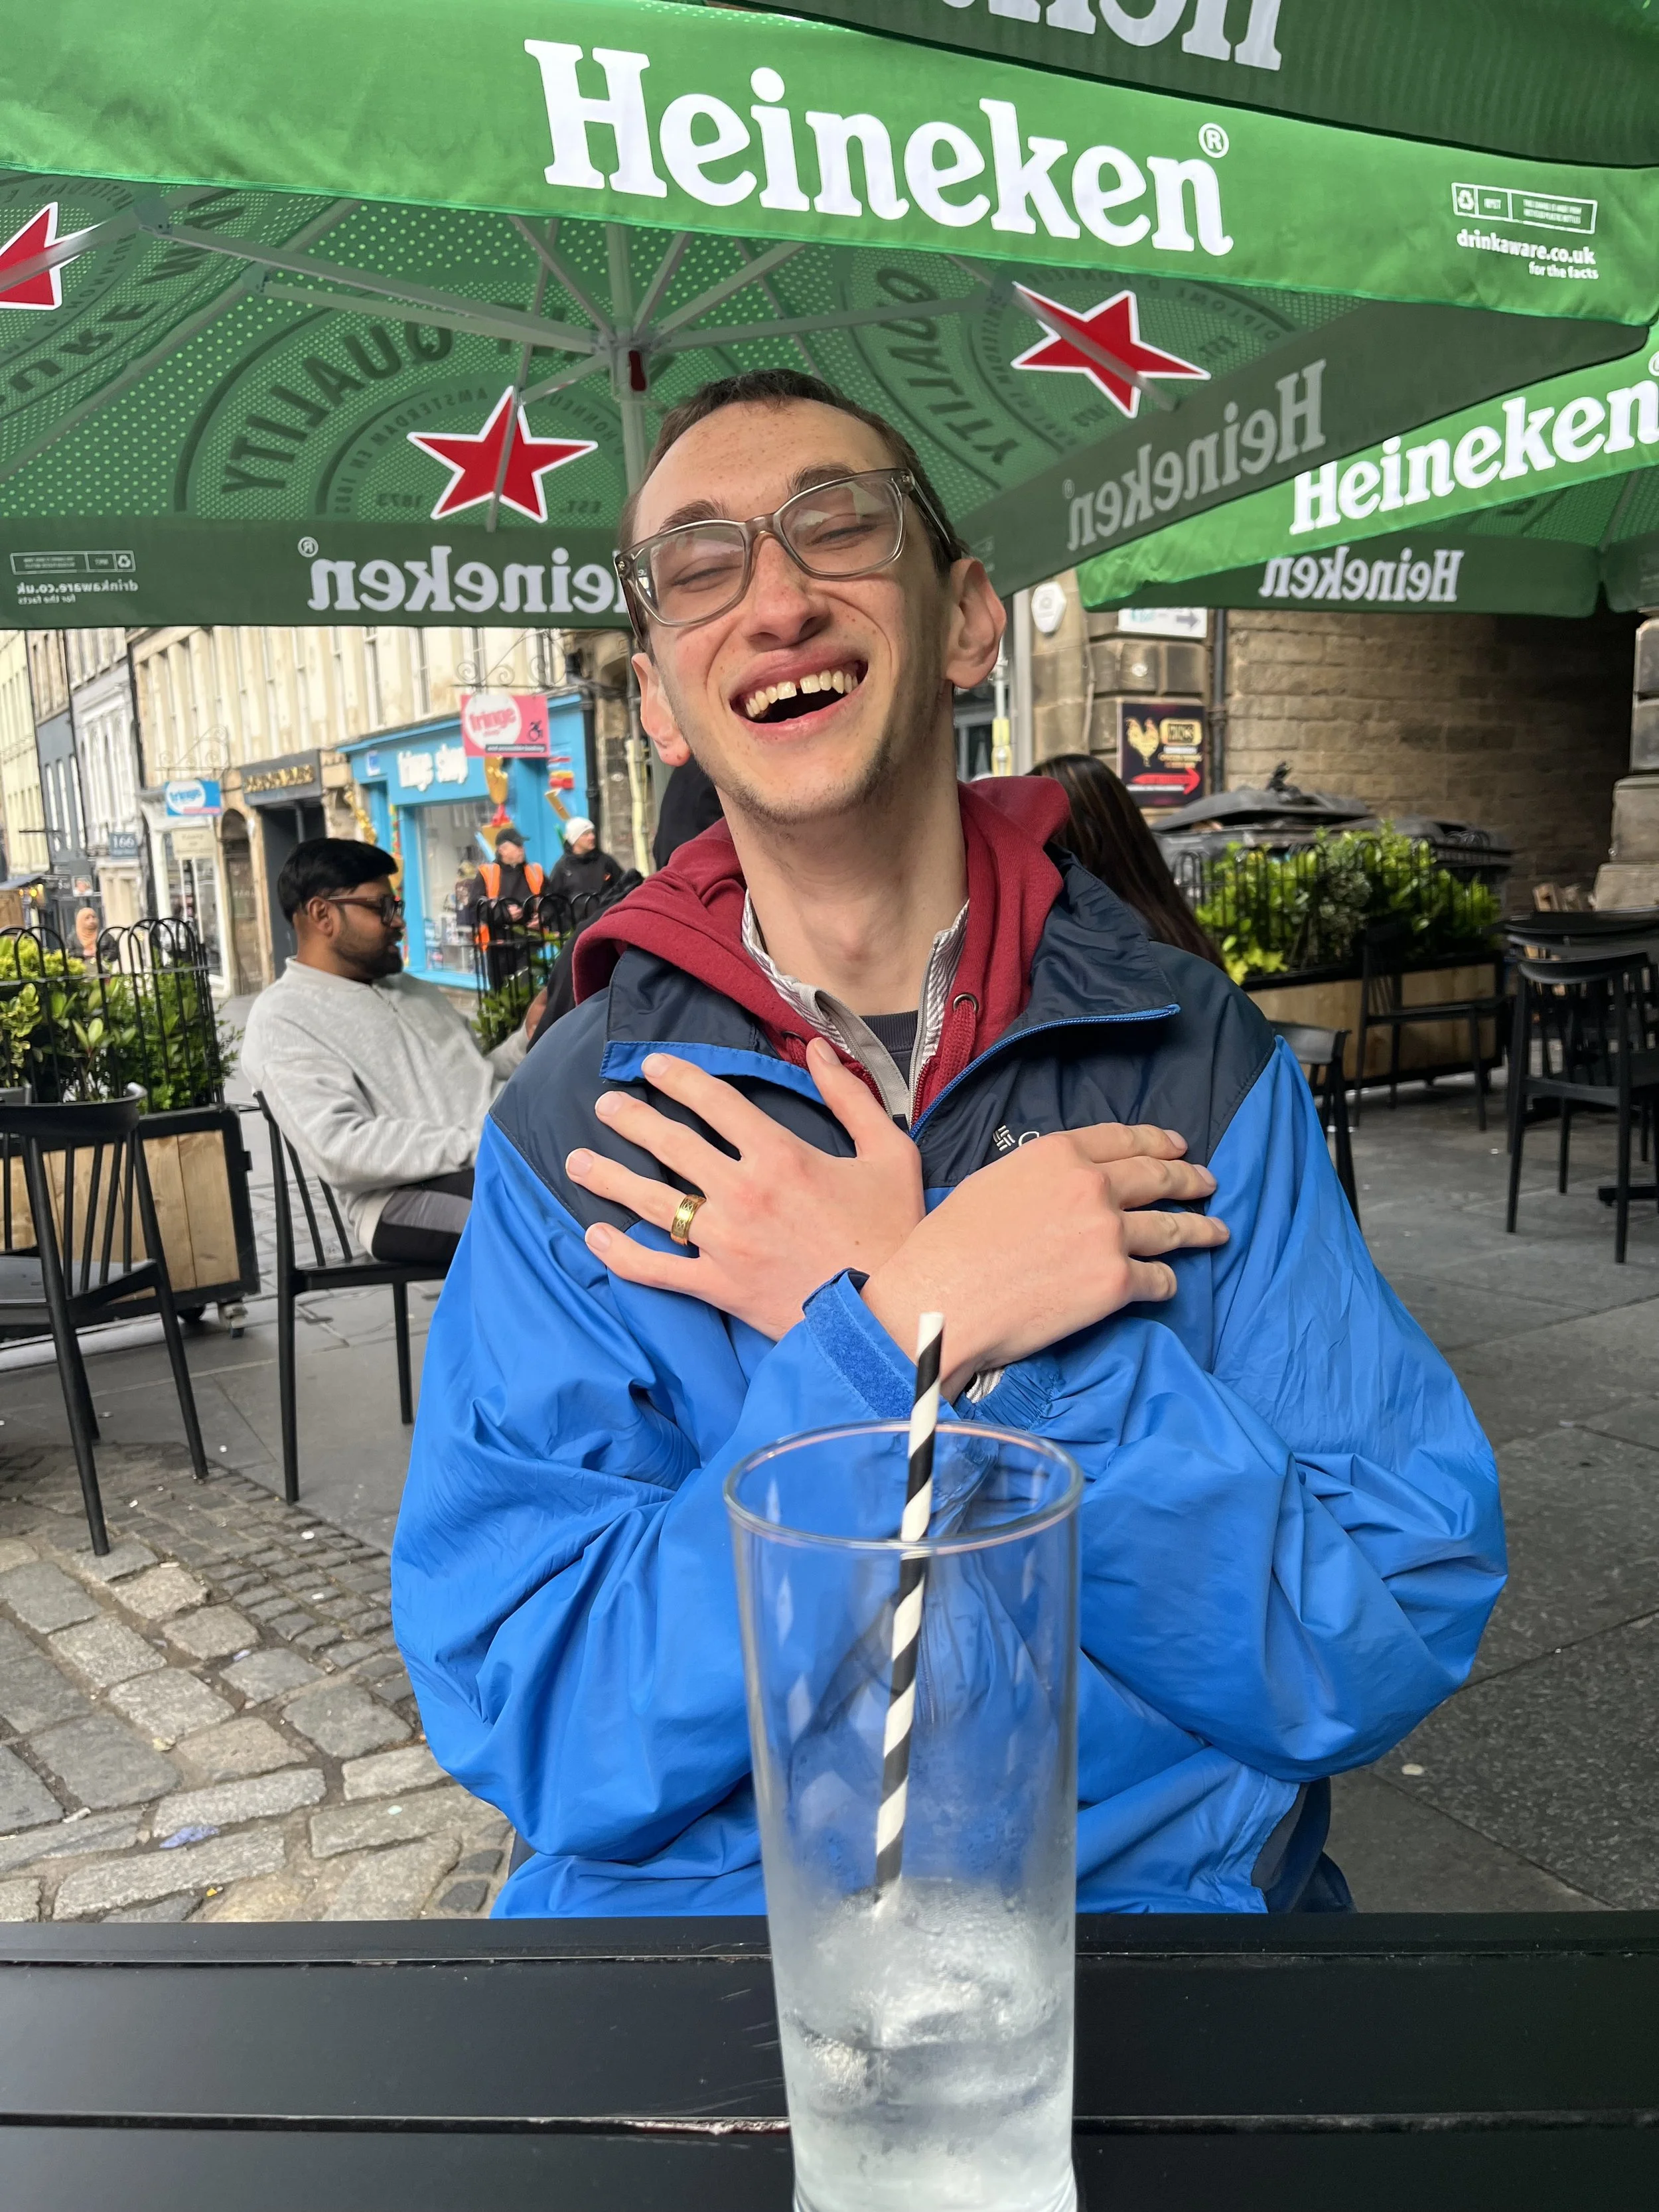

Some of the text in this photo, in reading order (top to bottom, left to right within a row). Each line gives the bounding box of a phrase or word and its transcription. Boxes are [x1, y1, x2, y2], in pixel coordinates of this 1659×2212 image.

[1457, 228, 1596, 265] drinkaware.co.uk
[1528, 261, 1599, 279] for the facts
[113, 835, 135, 848] 166
